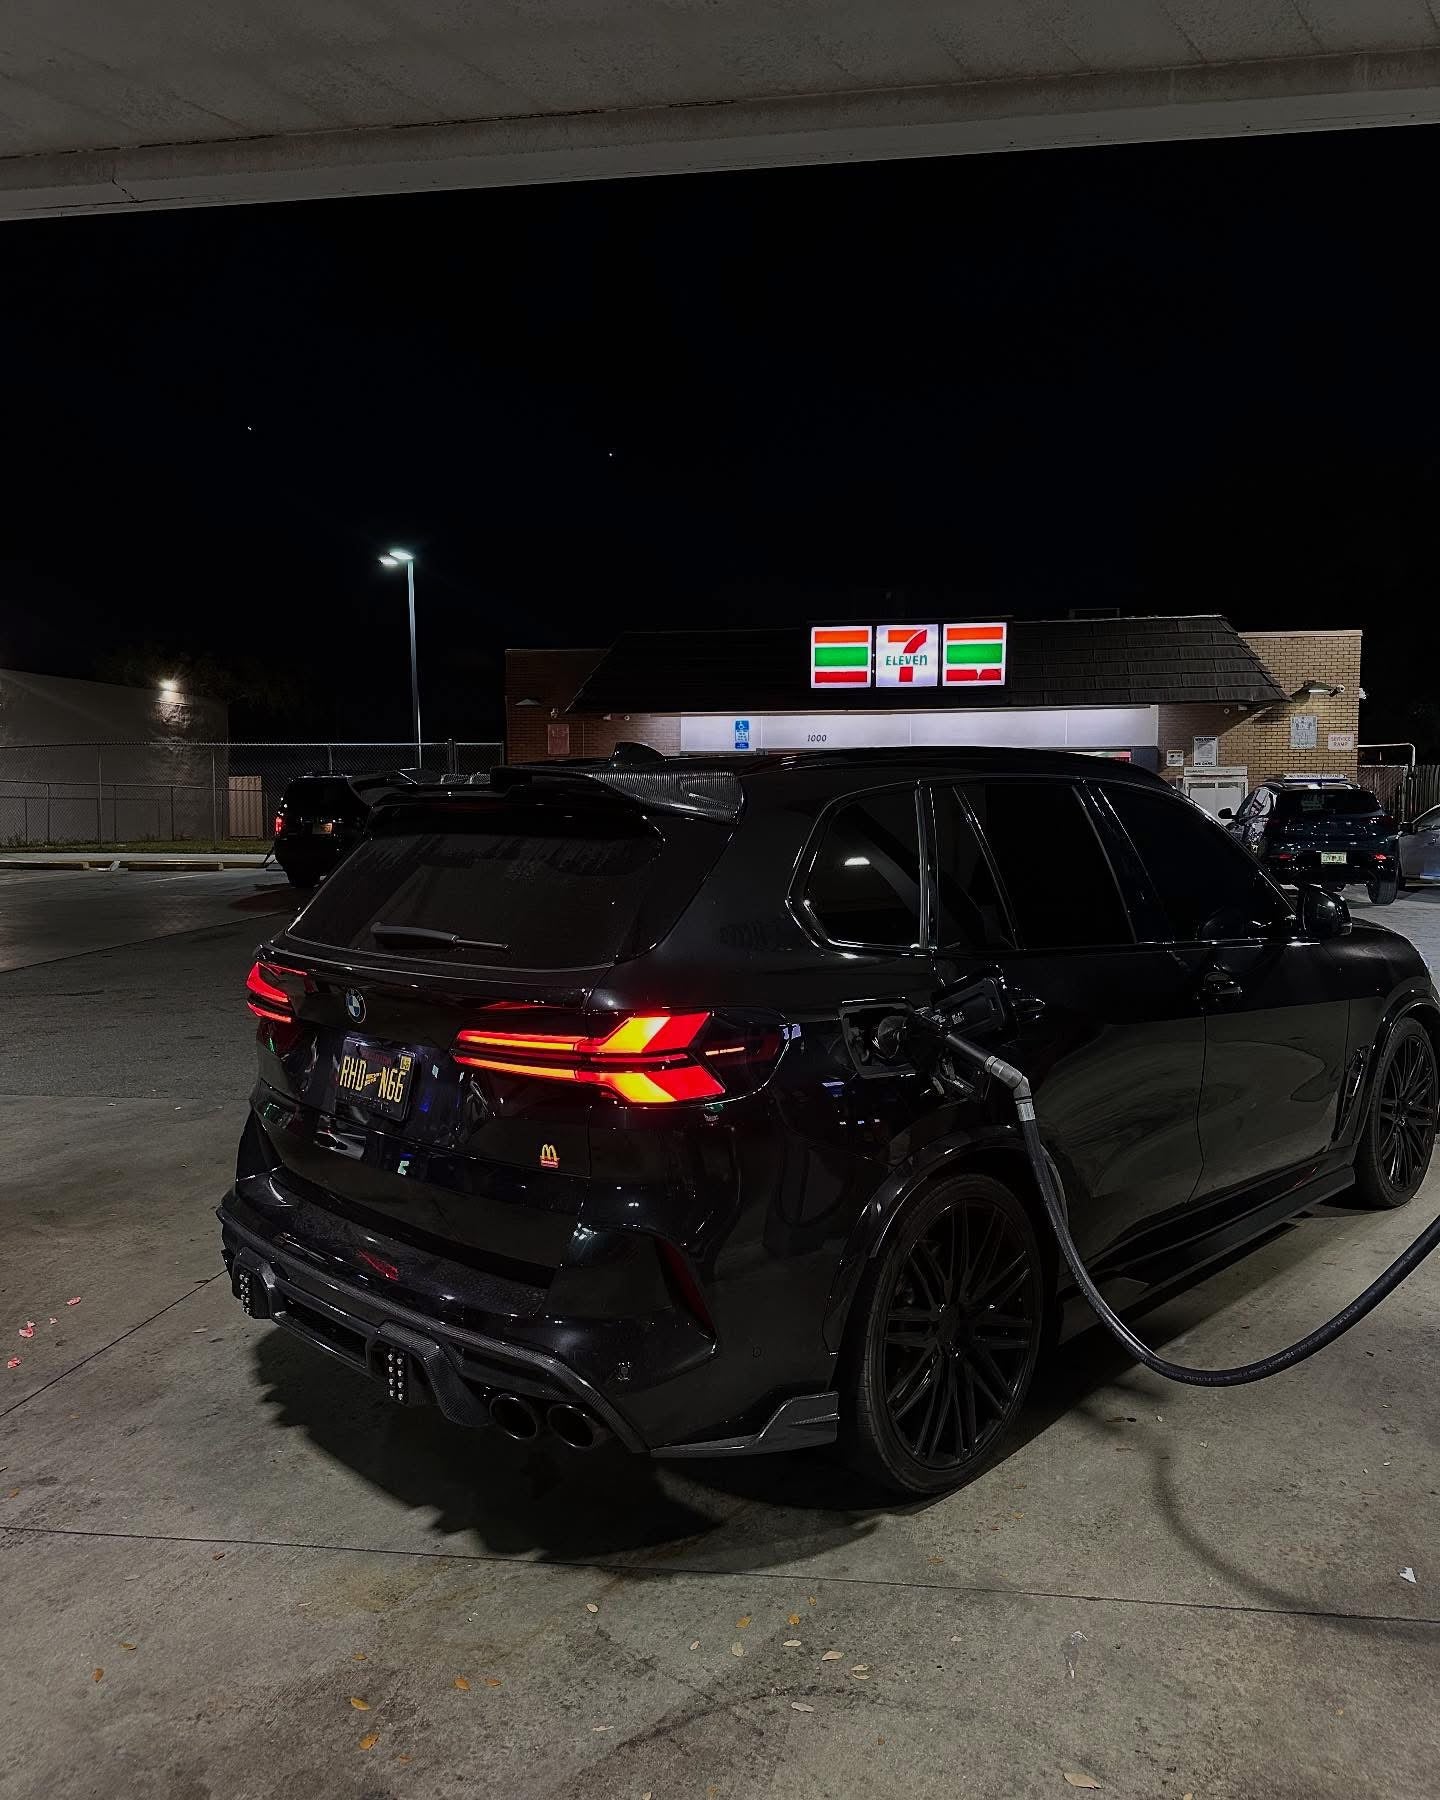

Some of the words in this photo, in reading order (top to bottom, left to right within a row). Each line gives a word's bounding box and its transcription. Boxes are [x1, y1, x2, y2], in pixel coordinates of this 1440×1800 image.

[887, 629, 928, 682] 7
[807, 734, 827, 742] 1000
[378, 1066, 407, 1103] N66
